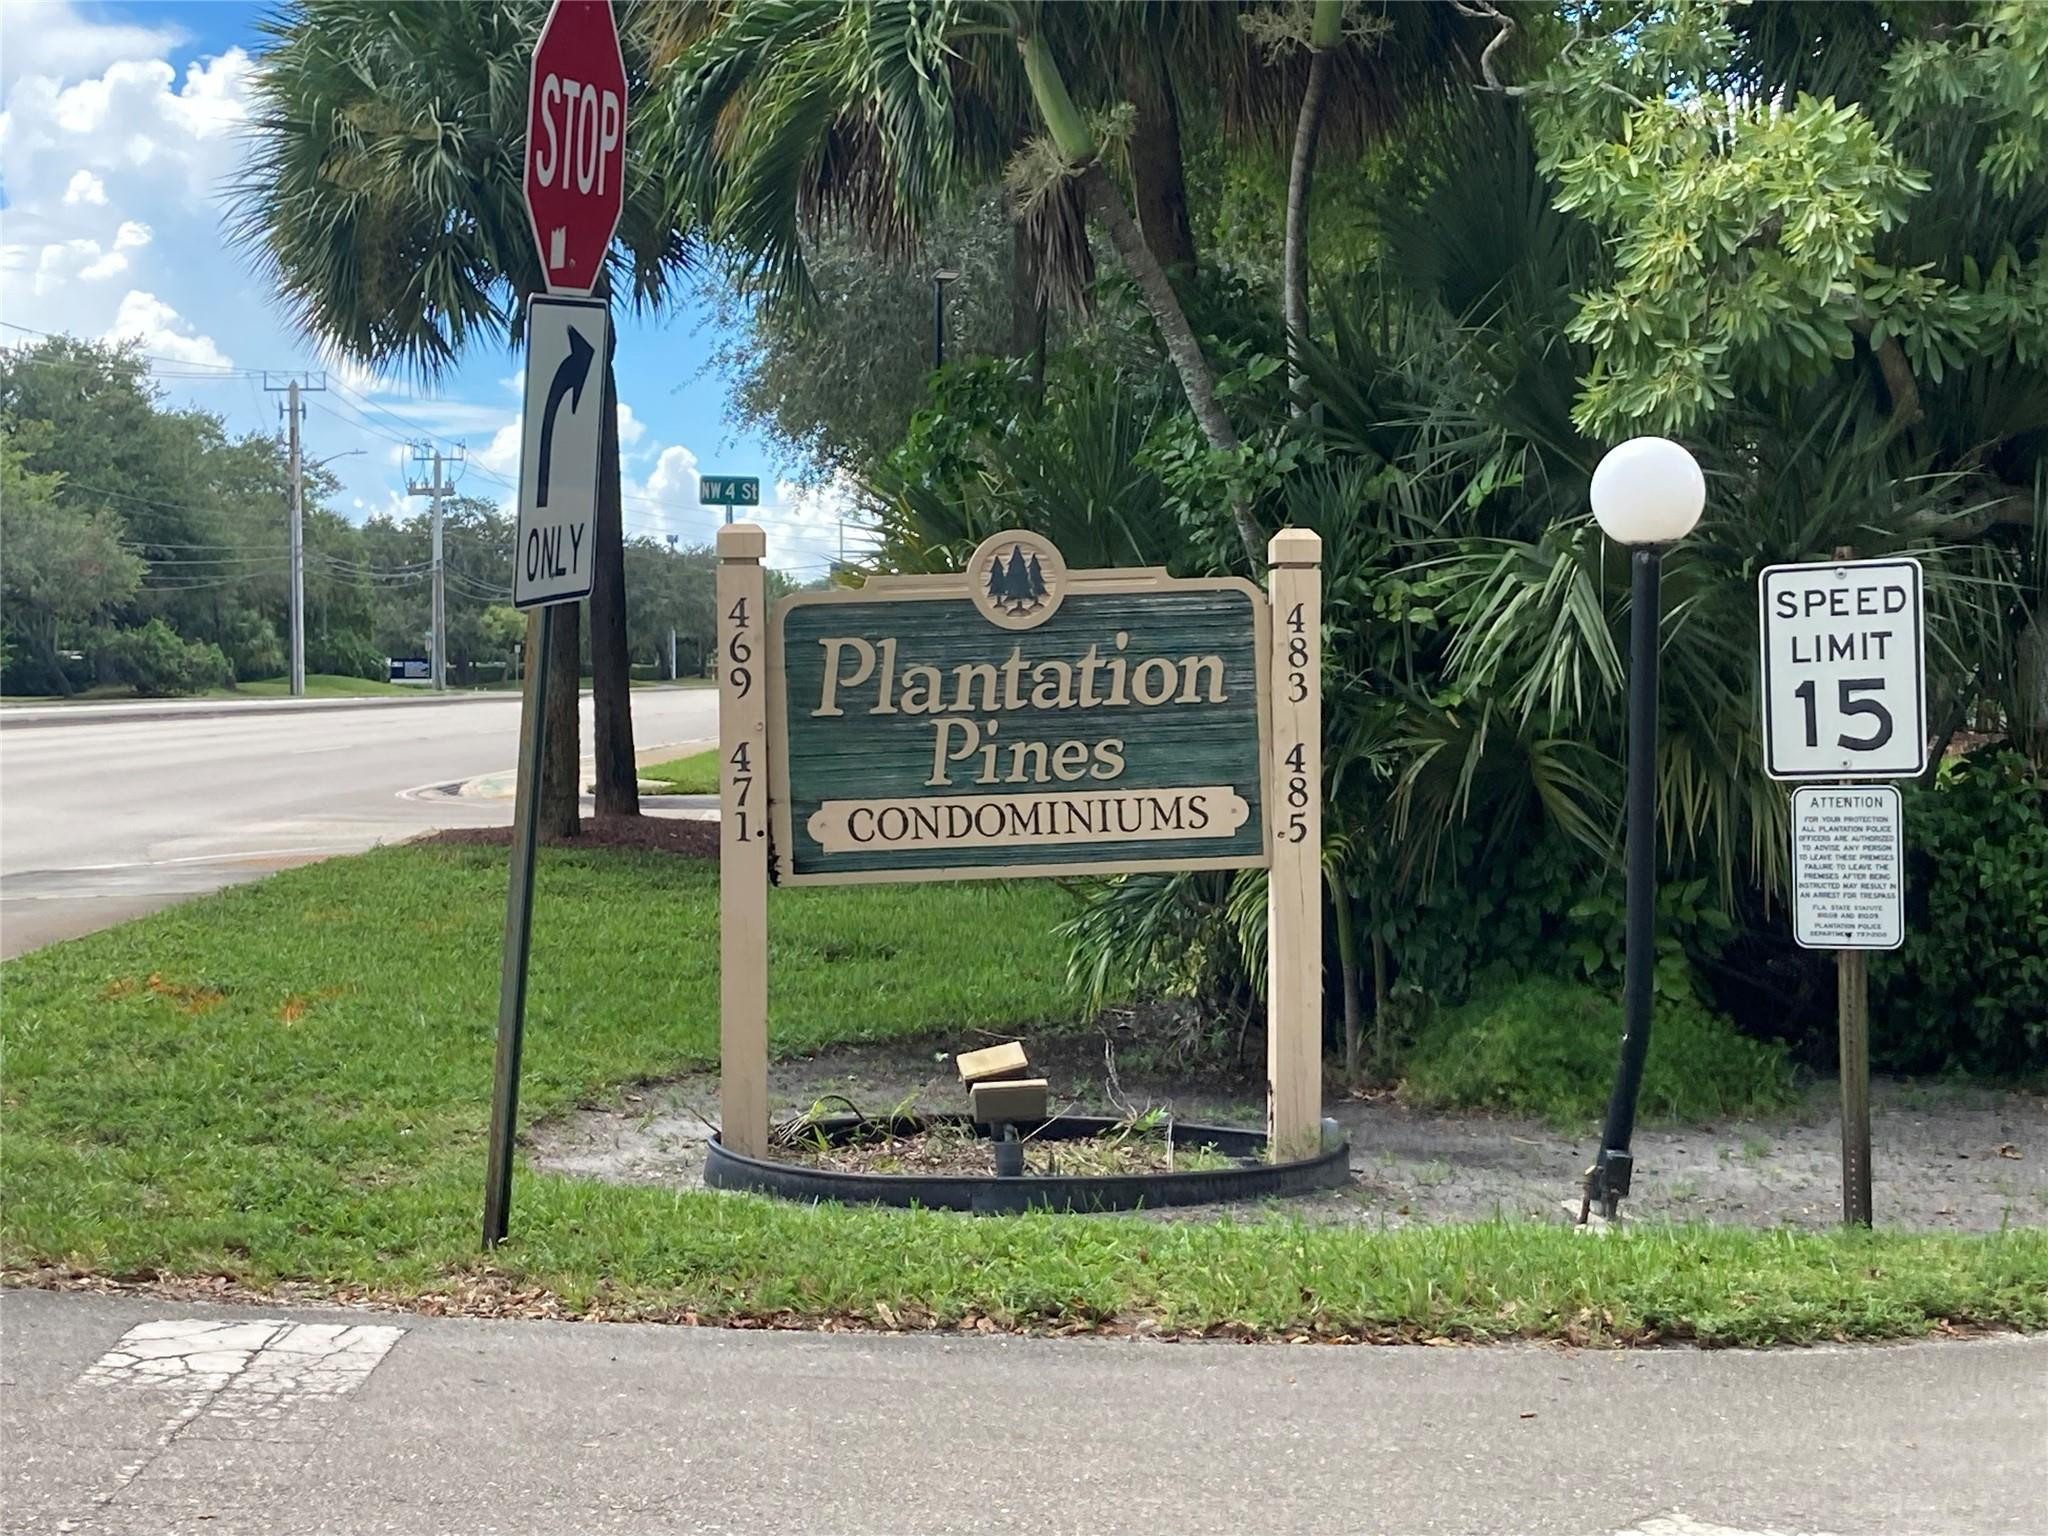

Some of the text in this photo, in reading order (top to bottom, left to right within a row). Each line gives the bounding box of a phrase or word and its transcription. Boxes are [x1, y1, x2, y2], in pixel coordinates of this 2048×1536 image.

[536, 73, 620, 196] STOP
[702, 482, 721, 499] NW
[725, 483, 735, 499] 4
[527, 523, 584, 582] ONLY
[1776, 585, 1907, 619] SPEED
[728, 597, 752, 699] 469
[811, 631, 1229, 718] Plantation
[1287, 603, 1308, 703] 483
[1792, 631, 1892, 663] LIMIT
[1795, 678, 1893, 752] 15
[924, 717, 1128, 788] Pines
[730, 742, 753, 842] 471
[847, 795, 1210, 843] CONDOMINIUMS
[1285, 743, 1308, 843] 485
[1810, 796, 1883, 808] ATTENTION
